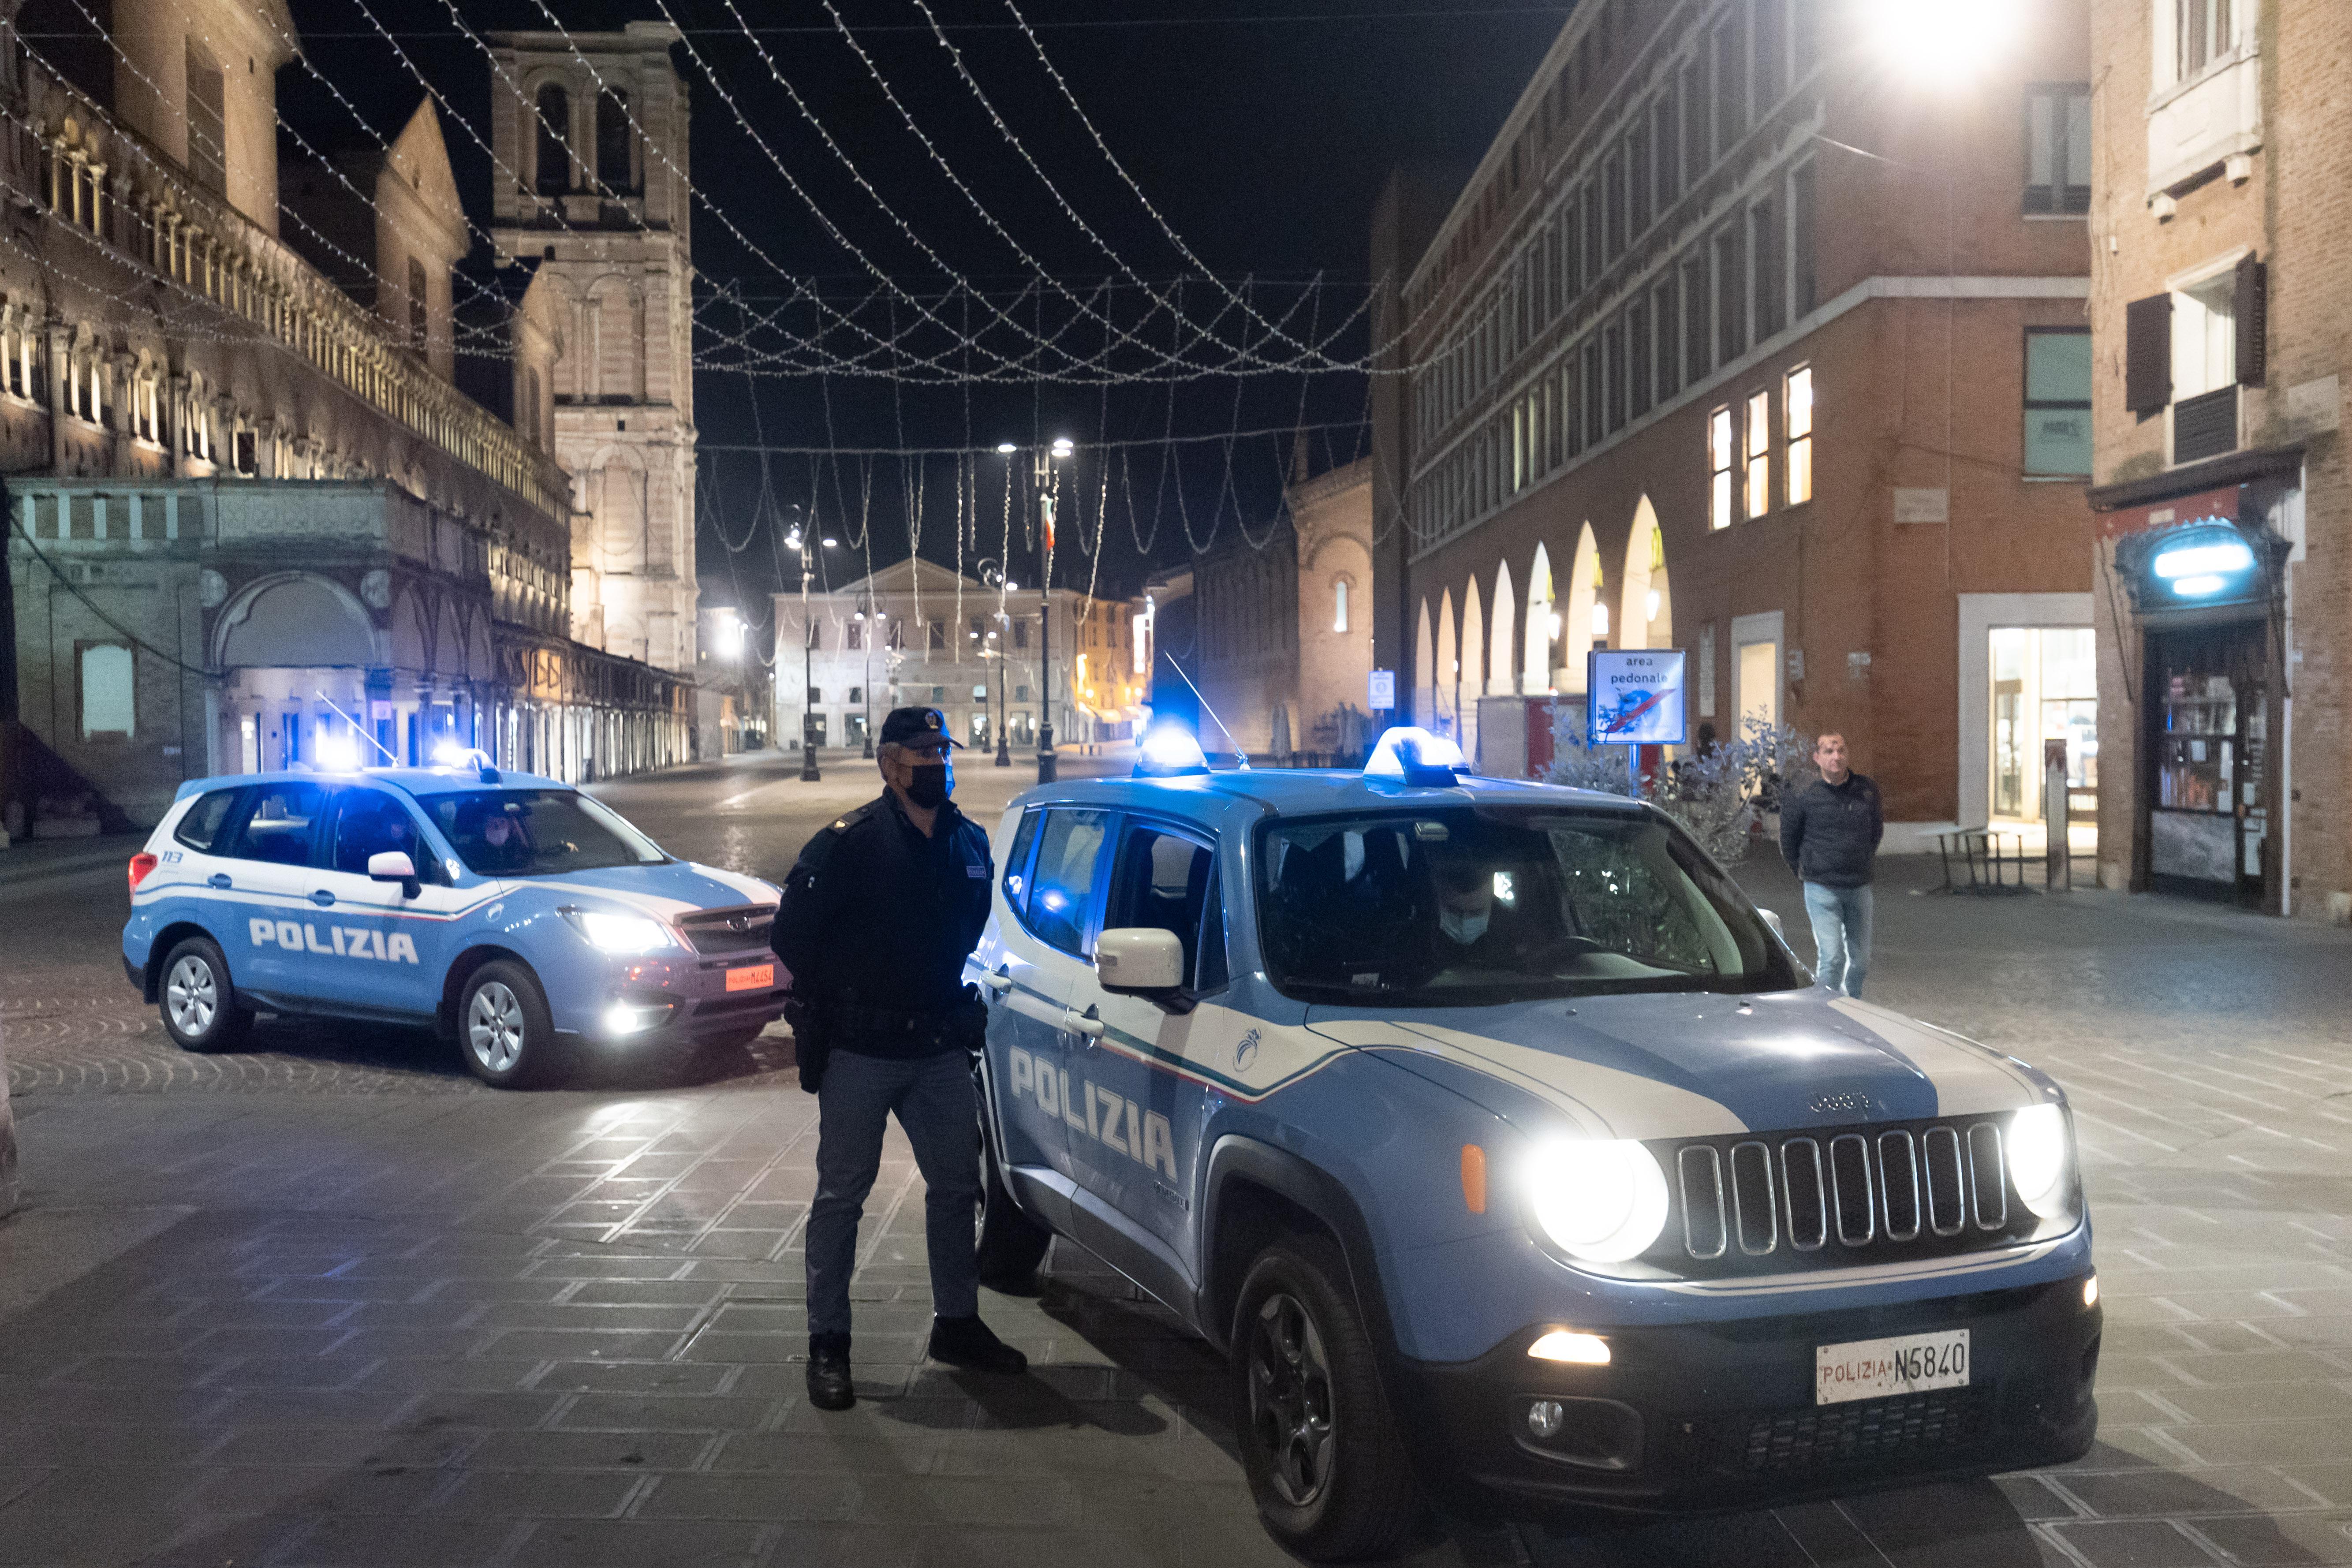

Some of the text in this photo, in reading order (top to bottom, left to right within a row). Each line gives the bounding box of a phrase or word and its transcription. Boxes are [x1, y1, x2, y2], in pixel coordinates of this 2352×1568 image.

[1626, 657, 1654, 666] area
[1611, 672, 1668, 685] pedonale
[161, 851, 184, 864] 113
[249, 918, 419, 964] POLIZIA
[1009, 1045, 1178, 1183] POLIZIA
[1807, 1091, 1873, 1121] Jeep
[1823, 1342, 1965, 1384] POLIZIA N5840
